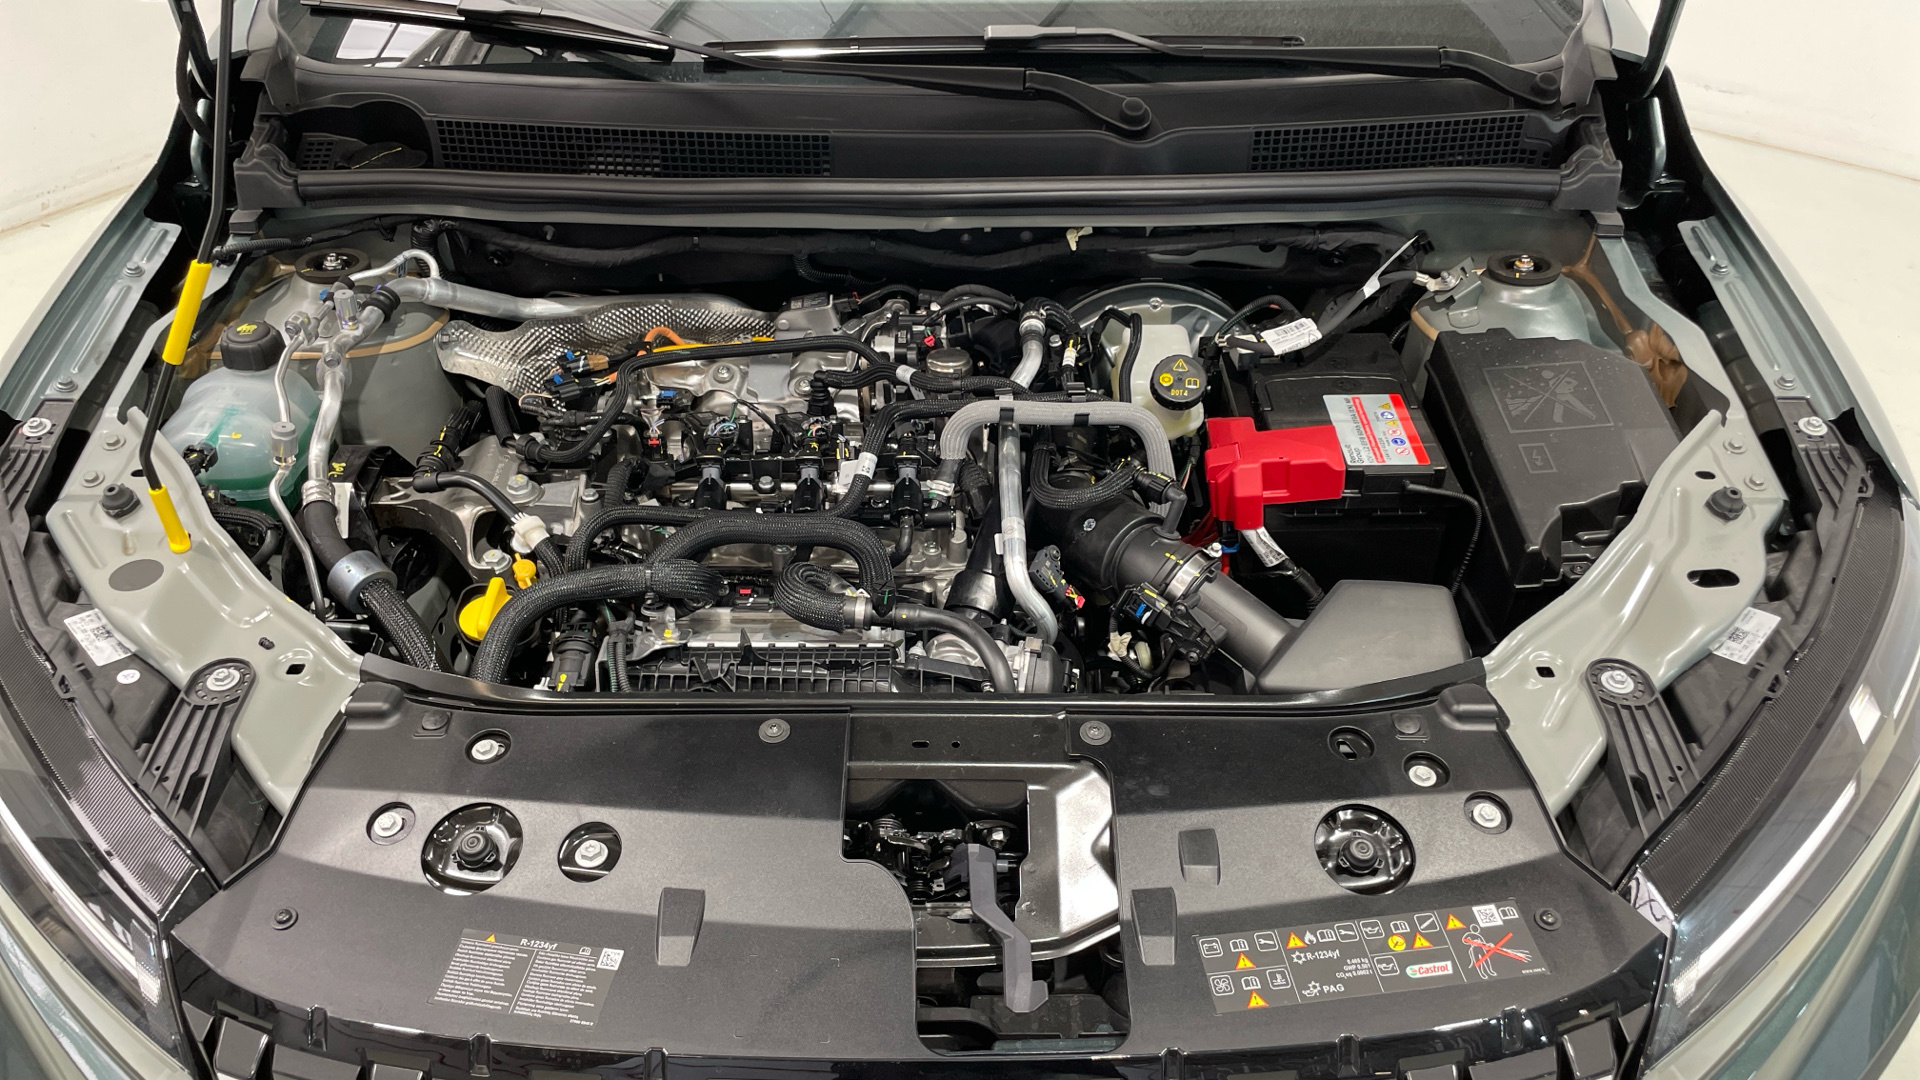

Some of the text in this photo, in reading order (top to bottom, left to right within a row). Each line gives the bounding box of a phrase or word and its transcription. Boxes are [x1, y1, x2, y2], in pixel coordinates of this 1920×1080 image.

[520, 938, 558, 951] R-1234yf
[1306, 949, 1340, 960] R-1234yf
[1418, 963, 1448, 975] Castrol
[1323, 984, 1344, 993] PAG
